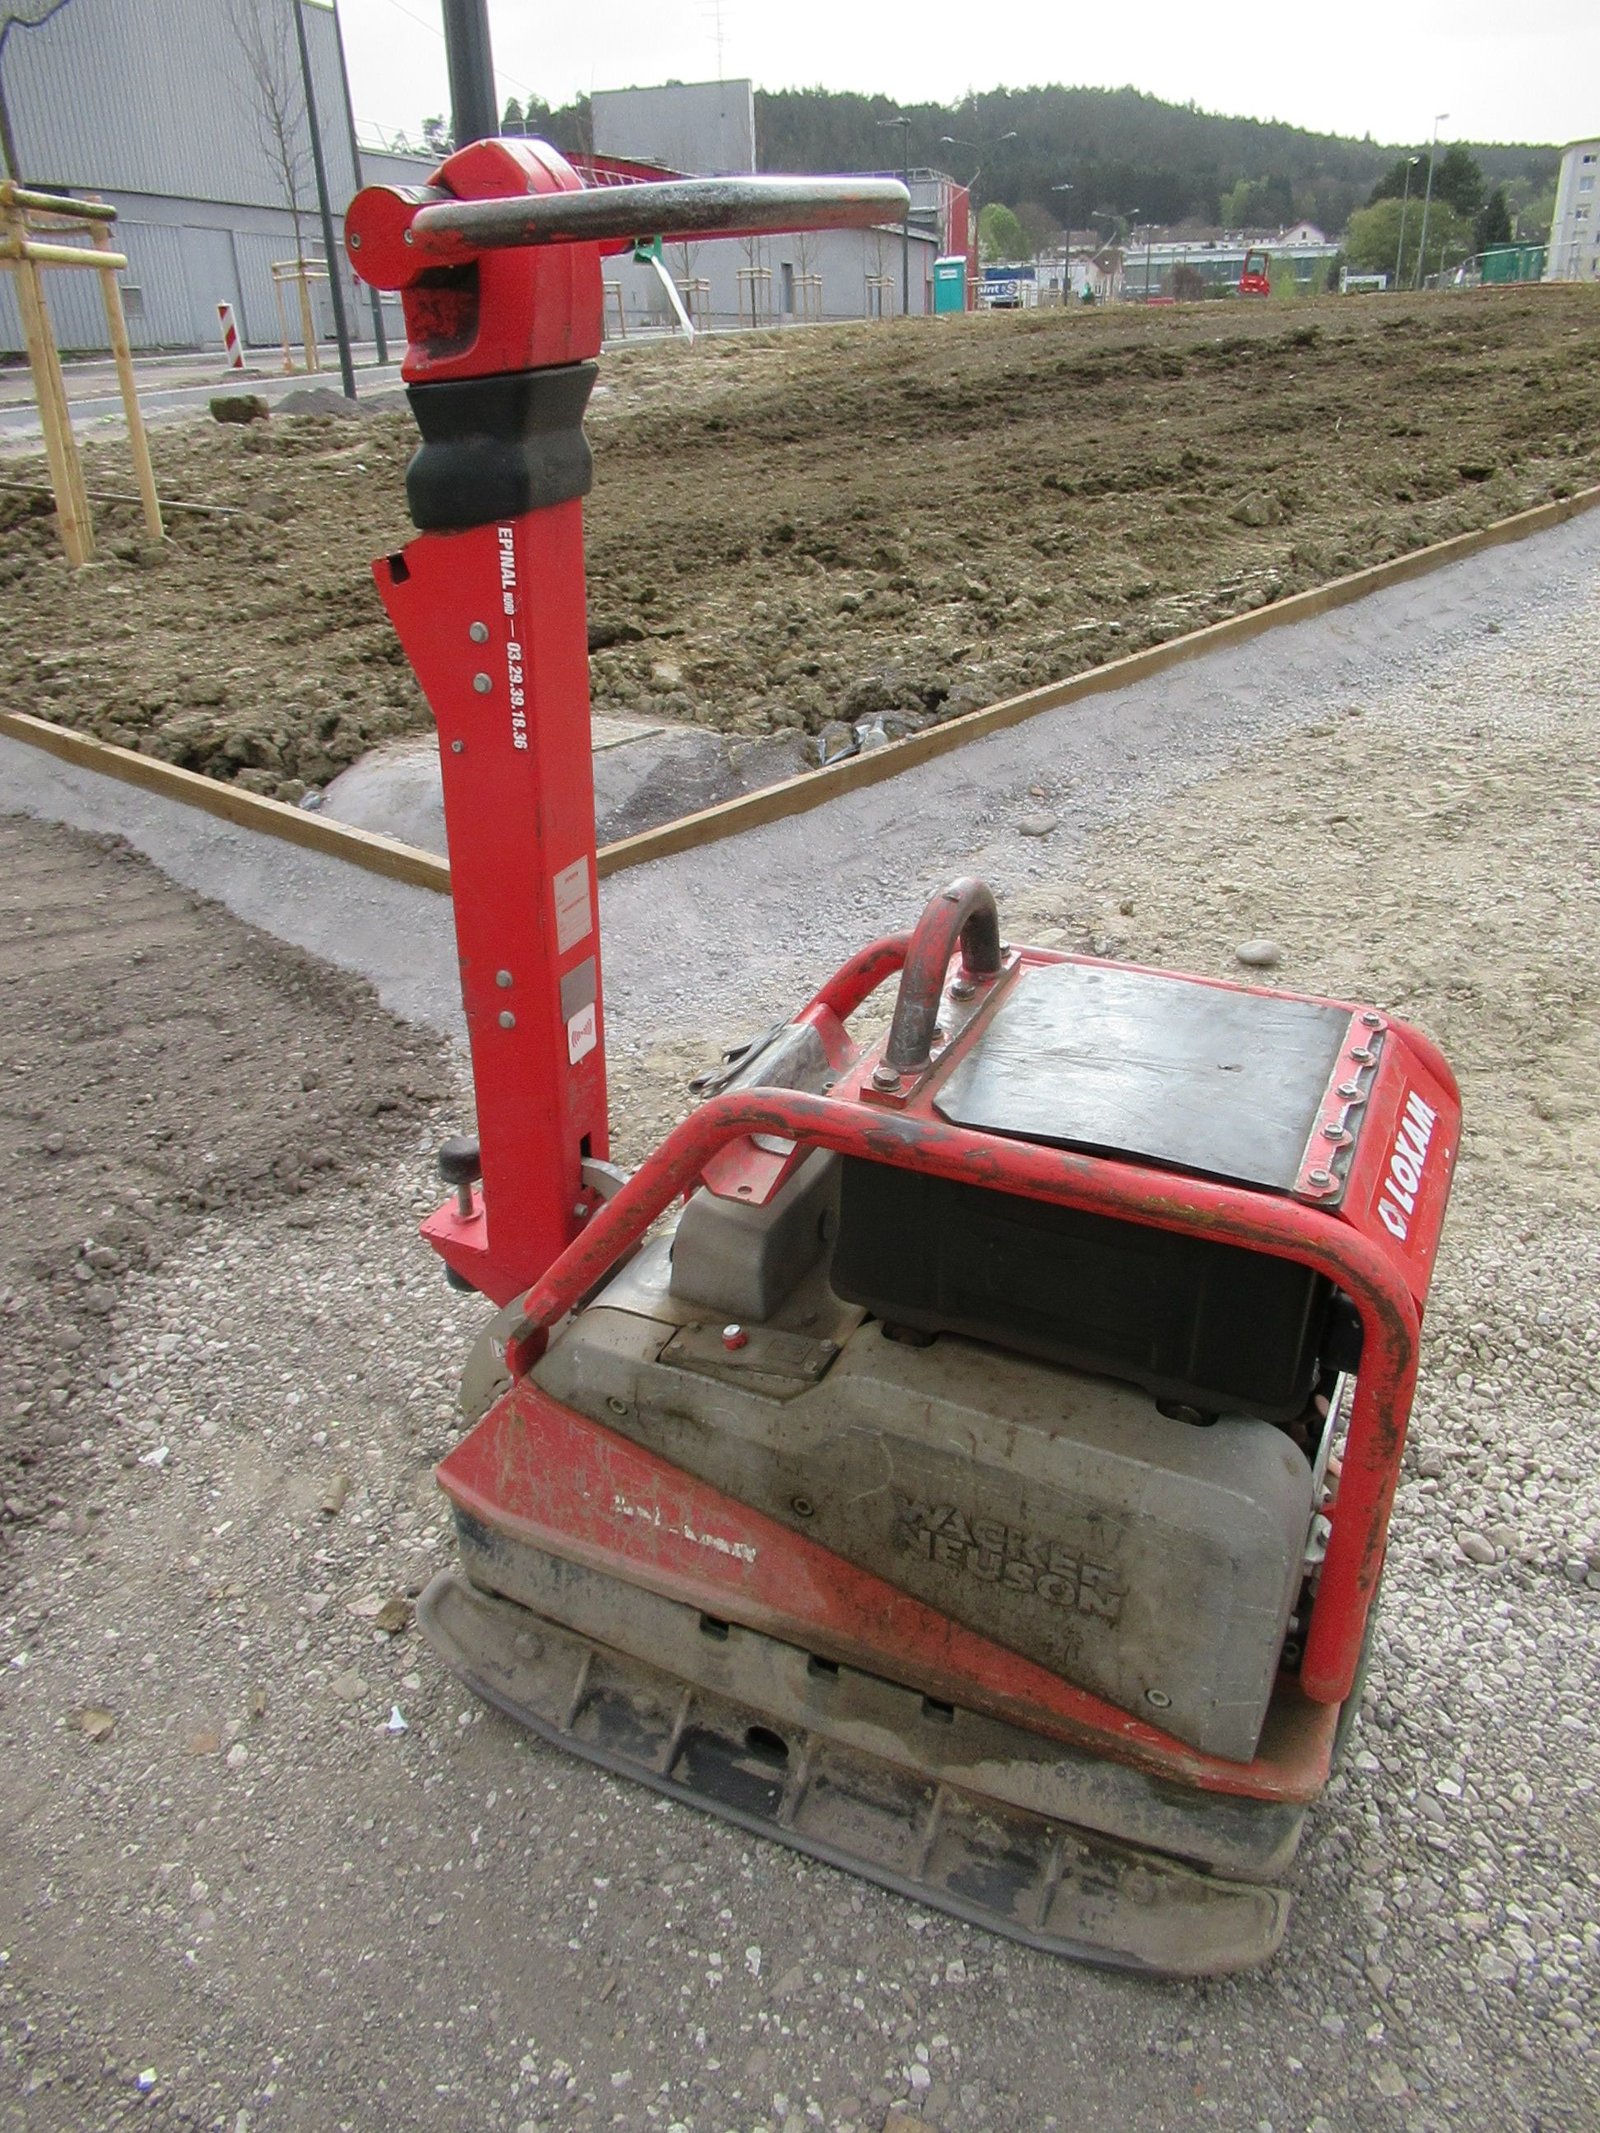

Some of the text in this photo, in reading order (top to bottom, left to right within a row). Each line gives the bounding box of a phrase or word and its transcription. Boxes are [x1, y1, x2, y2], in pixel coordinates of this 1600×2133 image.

[497, 526, 517, 590] EPINAL
[506, 641, 528, 750] 03.29.39.18.36
[1384, 1090, 1438, 1215] LOXAM
[894, 1490, 1122, 1590] WACKER
[895, 1522, 1126, 1620] NEUSON
